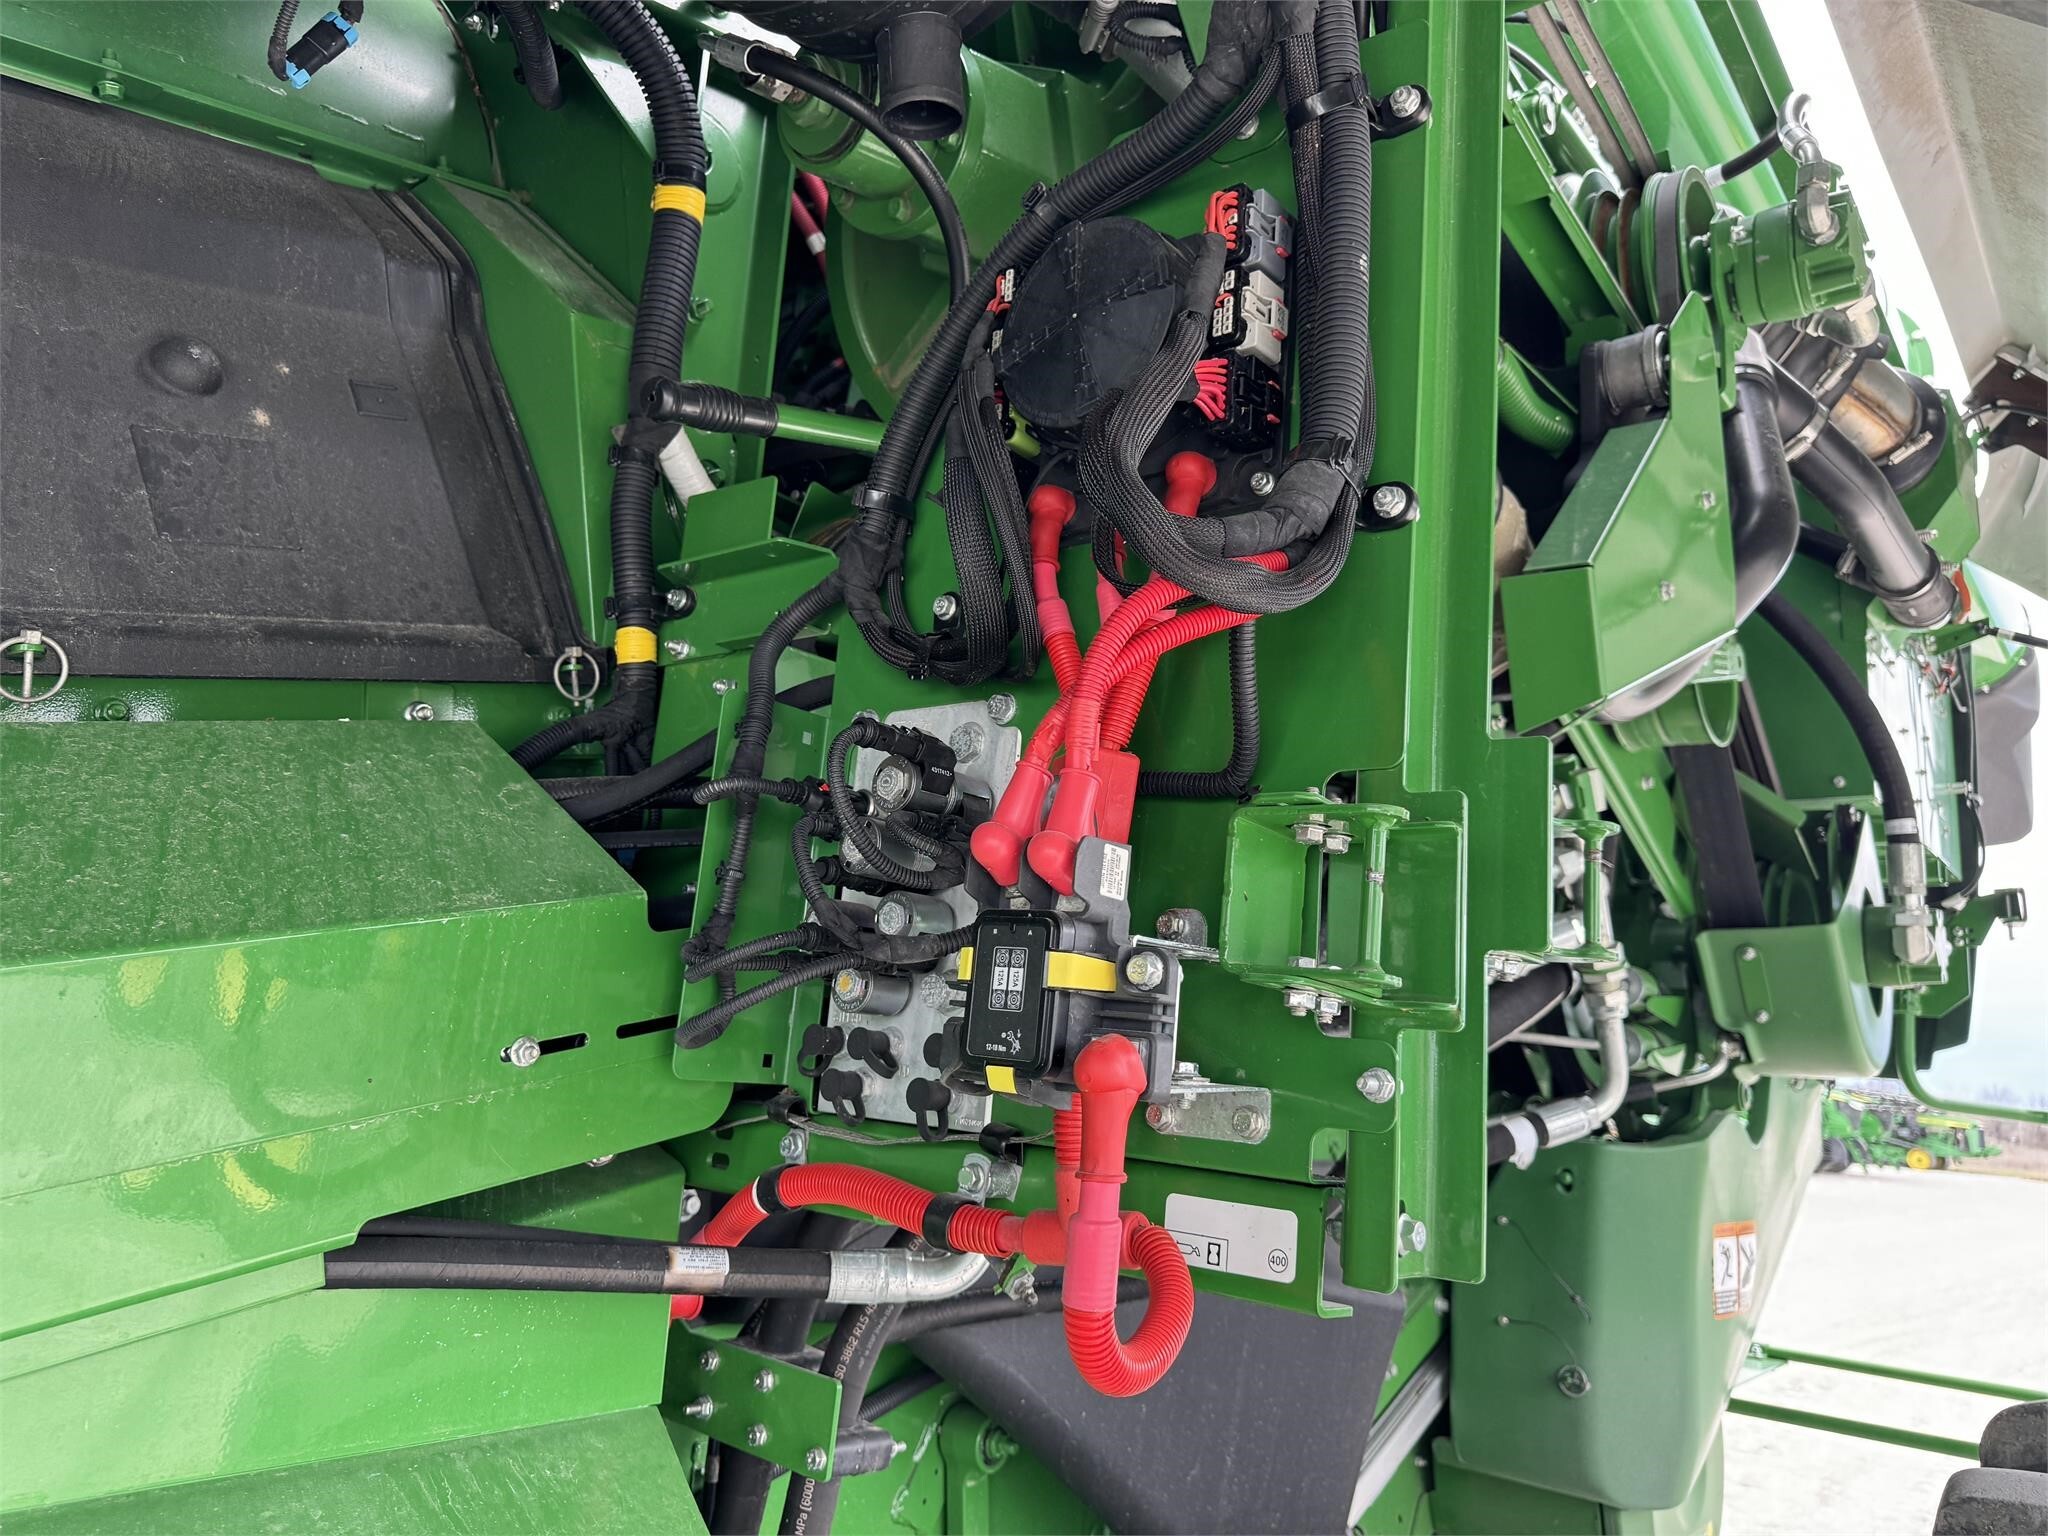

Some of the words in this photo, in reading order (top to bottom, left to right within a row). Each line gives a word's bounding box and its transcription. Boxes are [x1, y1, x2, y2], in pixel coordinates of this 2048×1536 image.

[1270, 1256, 1286, 1267] 400
[840, 1336, 859, 1363] 3862
[794, 1512, 808, 1536] MPa
